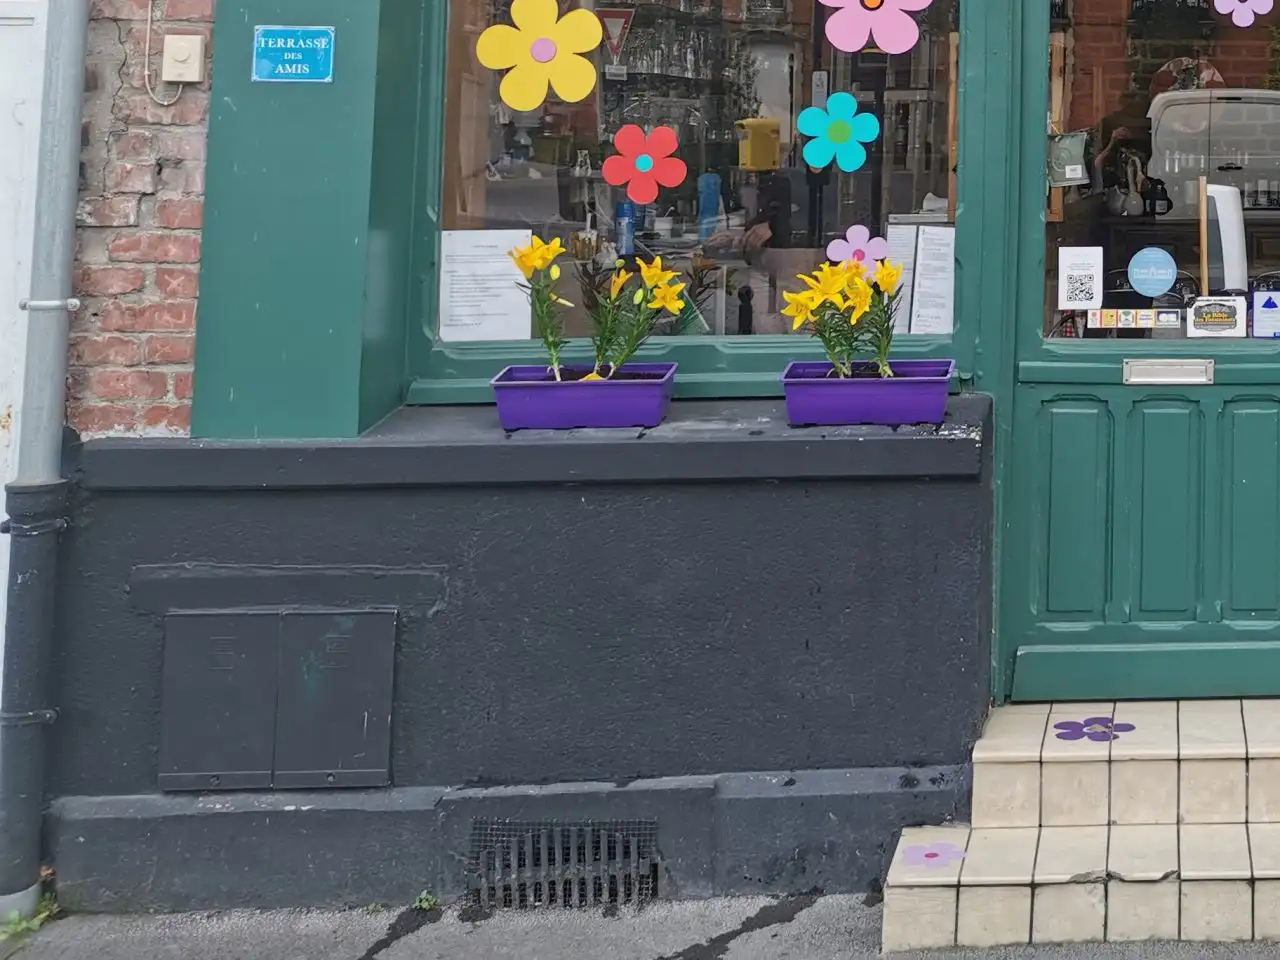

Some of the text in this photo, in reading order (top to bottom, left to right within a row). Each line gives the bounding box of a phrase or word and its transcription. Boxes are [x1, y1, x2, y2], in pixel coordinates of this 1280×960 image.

[259, 37, 329, 49] TERRASSE
[284, 52, 303, 60] DES
[275, 64, 310, 74] AMIS
